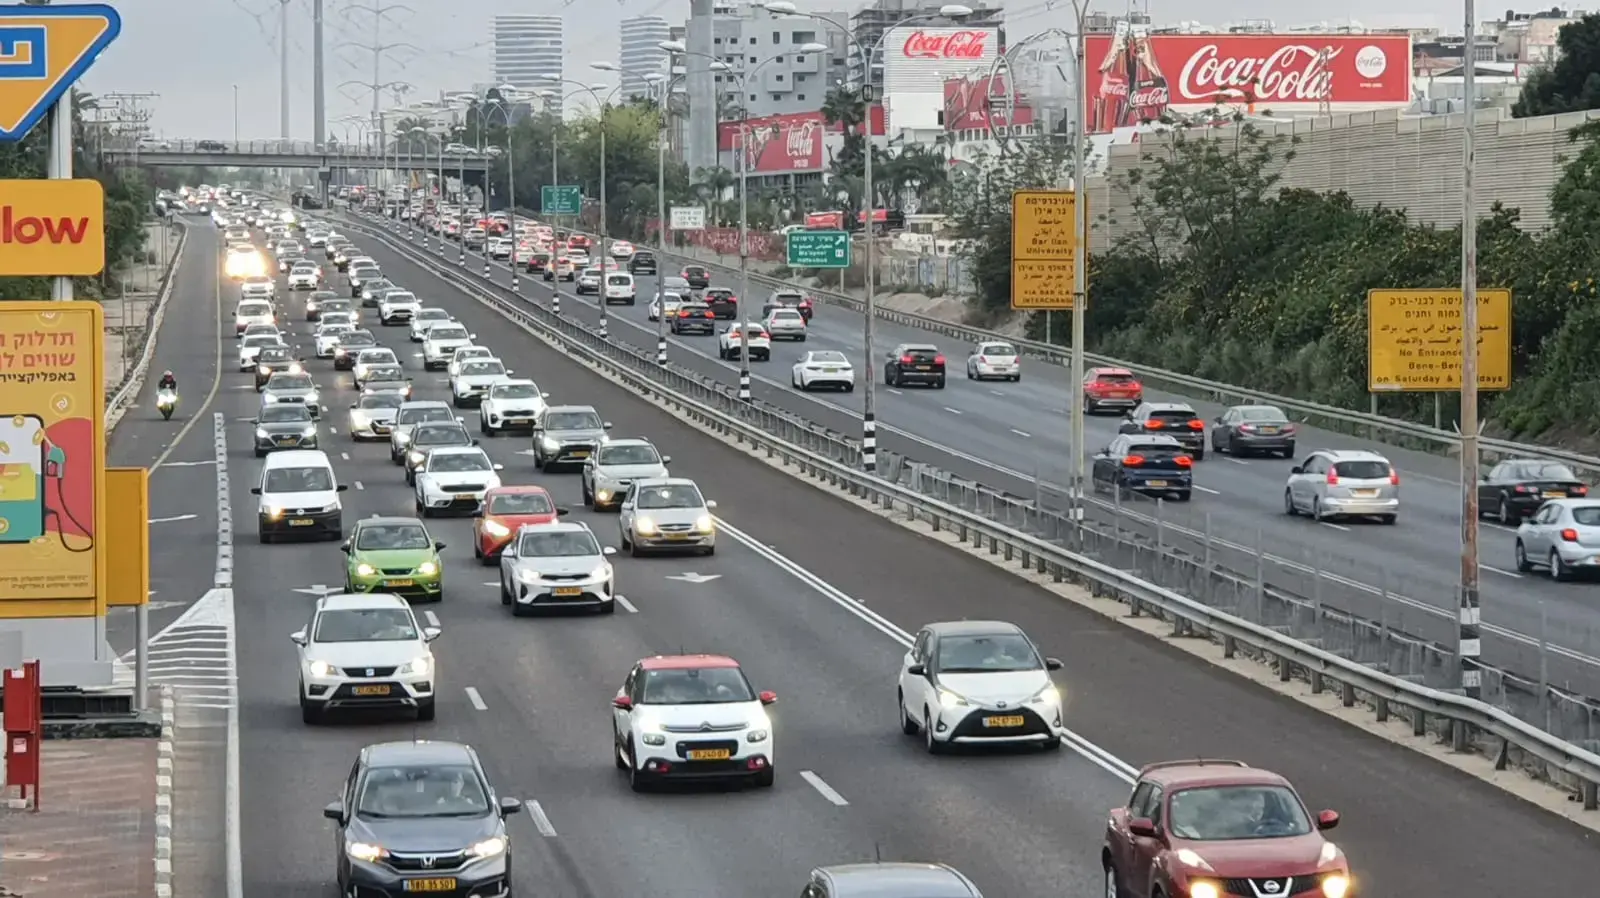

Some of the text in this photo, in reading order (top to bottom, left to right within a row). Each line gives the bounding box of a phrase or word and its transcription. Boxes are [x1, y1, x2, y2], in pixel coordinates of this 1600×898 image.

[903, 30, 989, 59] Coca-Cola
[1178, 44, 1345, 100] Coca-Cola
[1026, 247, 1073, 256] University
[1440, 296, 1463, 305] ניסה
[13, 330, 74, 350] תדלוק
[1400, 349, 1412, 357] No
[23, 352, 75, 367] שווים
[1408, 361, 1462, 370] Bene-Ber
[1395, 375, 1440, 384] Saturday
